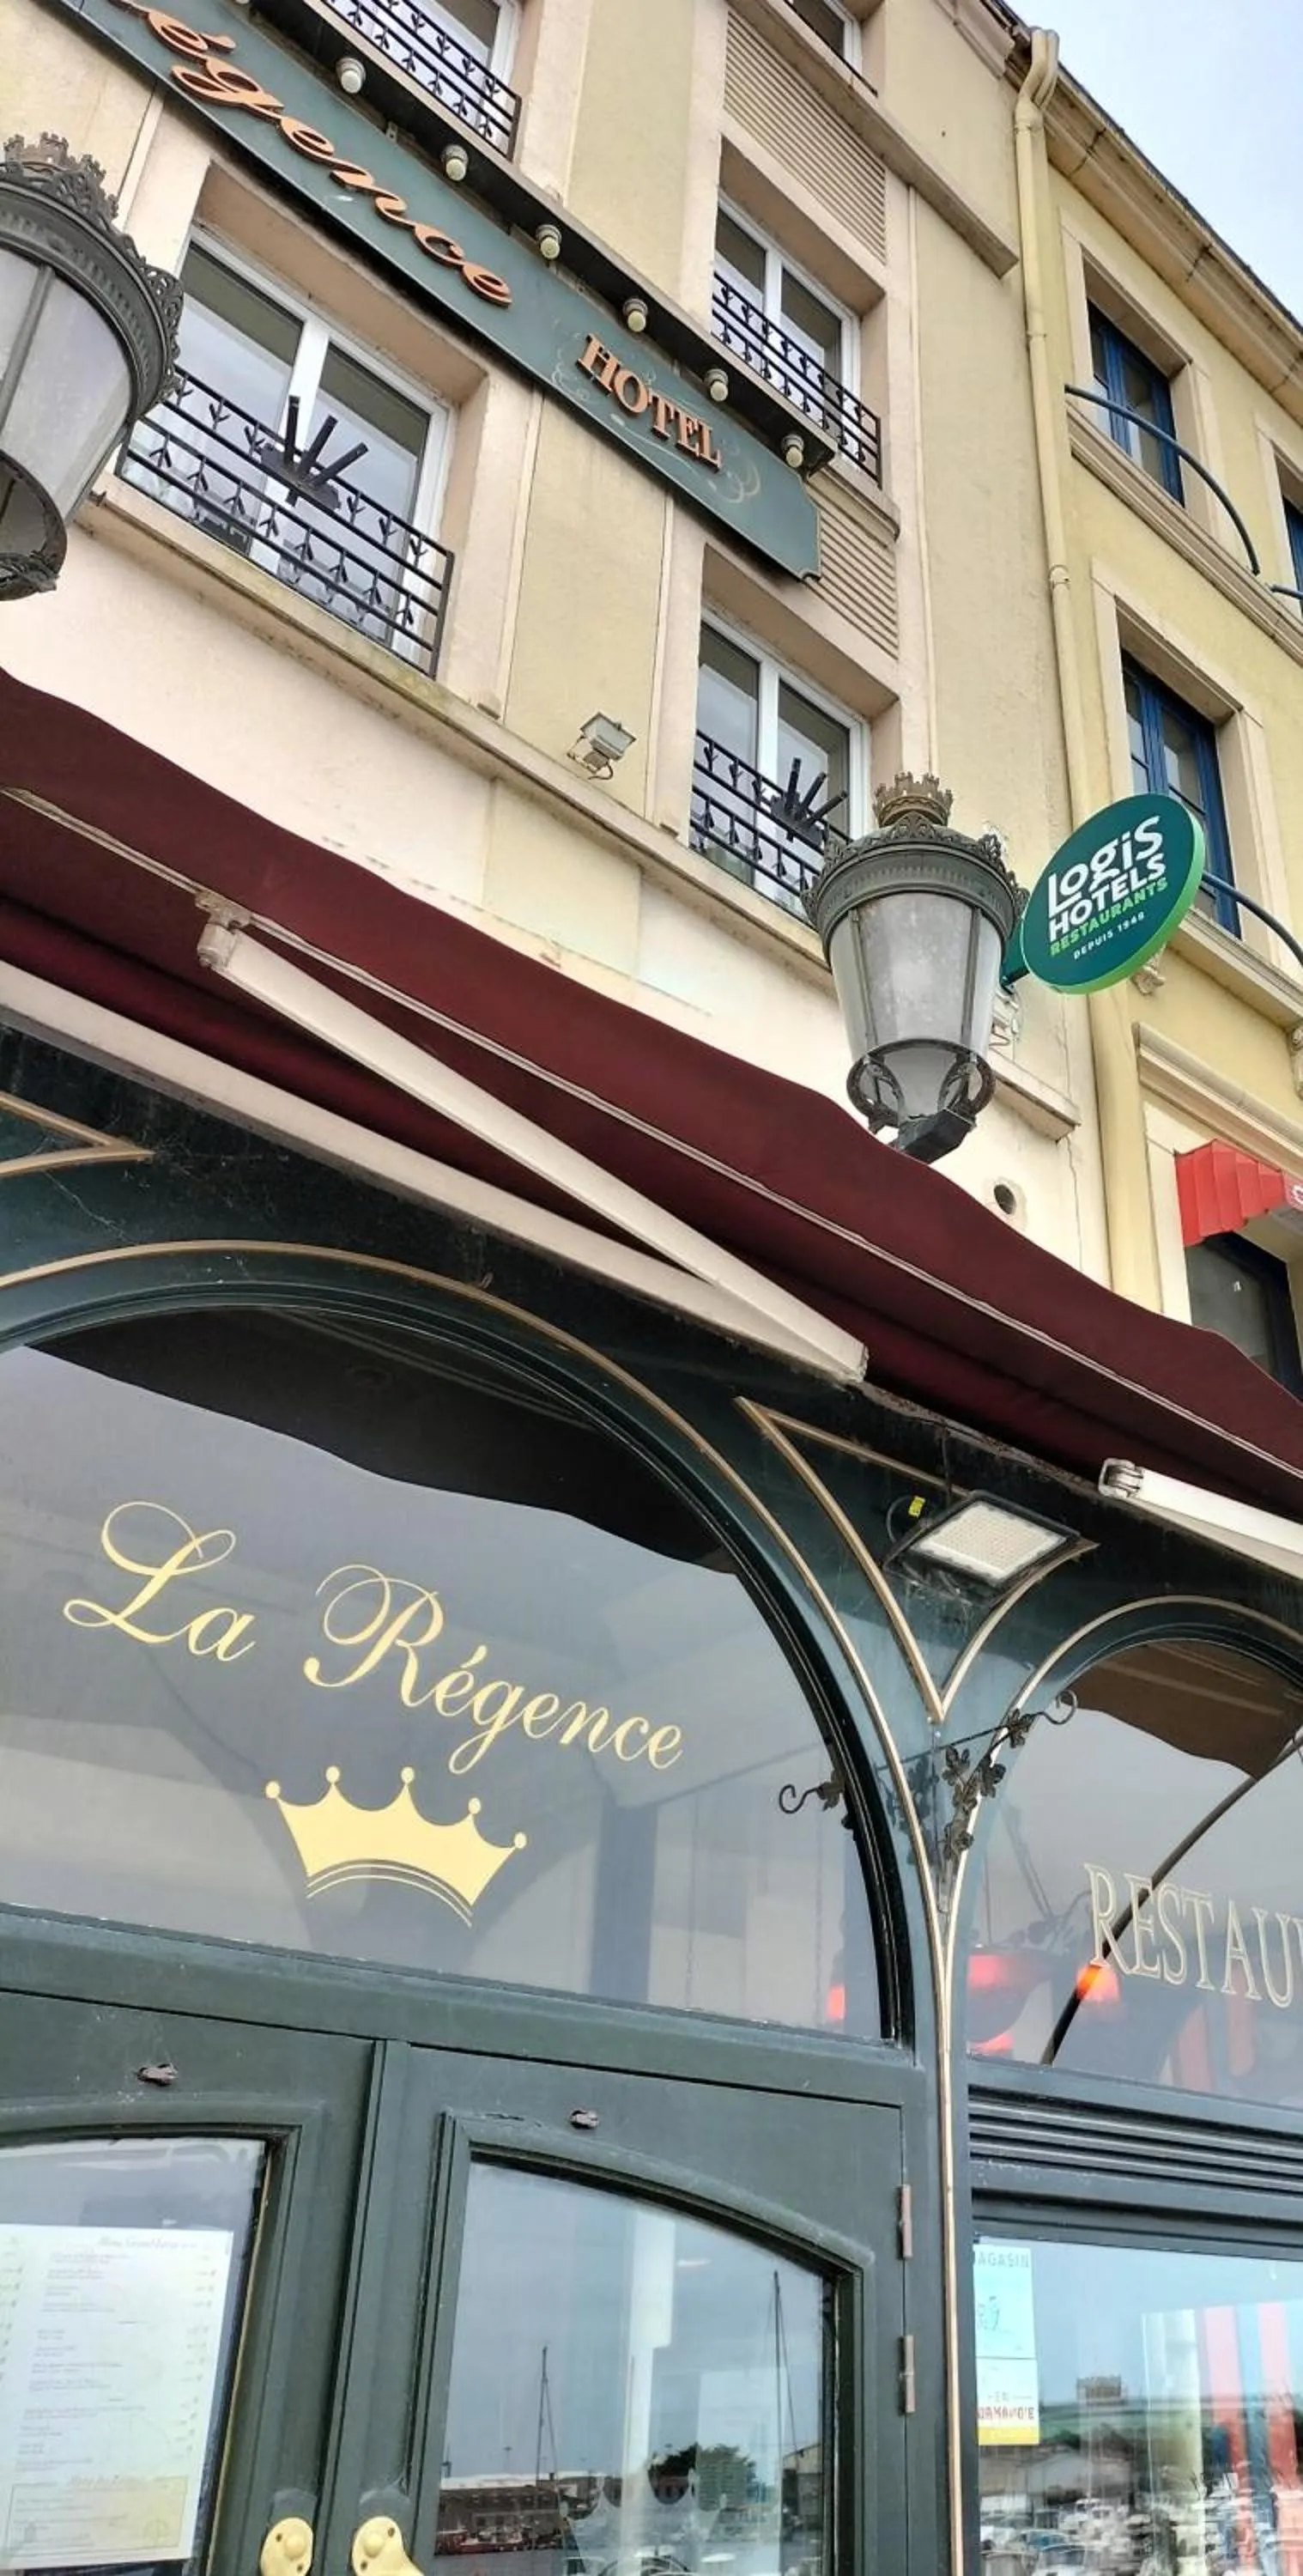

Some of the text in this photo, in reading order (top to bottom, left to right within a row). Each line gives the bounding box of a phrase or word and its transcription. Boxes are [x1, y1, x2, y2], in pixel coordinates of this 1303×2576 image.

[106, 0, 513, 307] égence
[576, 332, 722, 472] HOTEL
[1048, 853, 1167, 943] HOTELS
[1049, 877, 1168, 957] RESTAURANTS
[1073, 930, 1114, 962] DEPUIS
[63, 1501, 683, 1776] La Régence
[971, 2251, 1030, 2268] AGASIN
